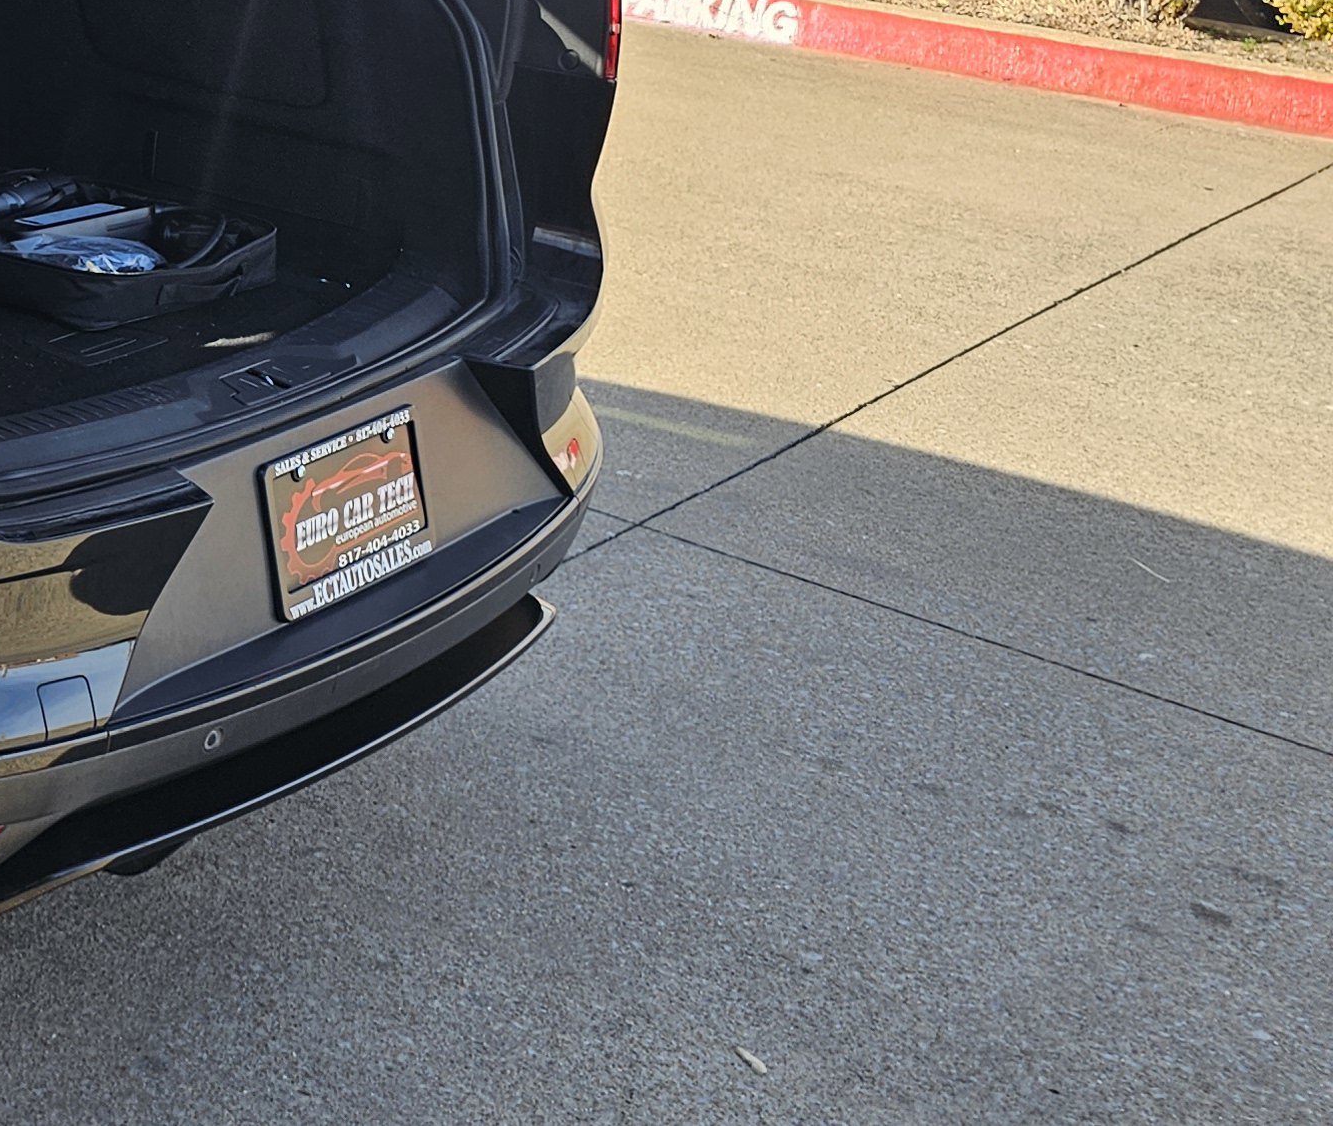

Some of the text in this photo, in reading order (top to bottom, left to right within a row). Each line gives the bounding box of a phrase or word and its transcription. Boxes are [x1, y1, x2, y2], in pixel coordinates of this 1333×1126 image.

[275, 454, 302, 477] SALES
[310, 434, 348, 461] SERVICE
[295, 472, 415, 552] EURO CAR TECH
[335, 499, 418, 545] european automotive
[338, 519, 421, 569] 817-404-4033
[289, 539, 434, 621] www.ECTAUTOSALES.com
